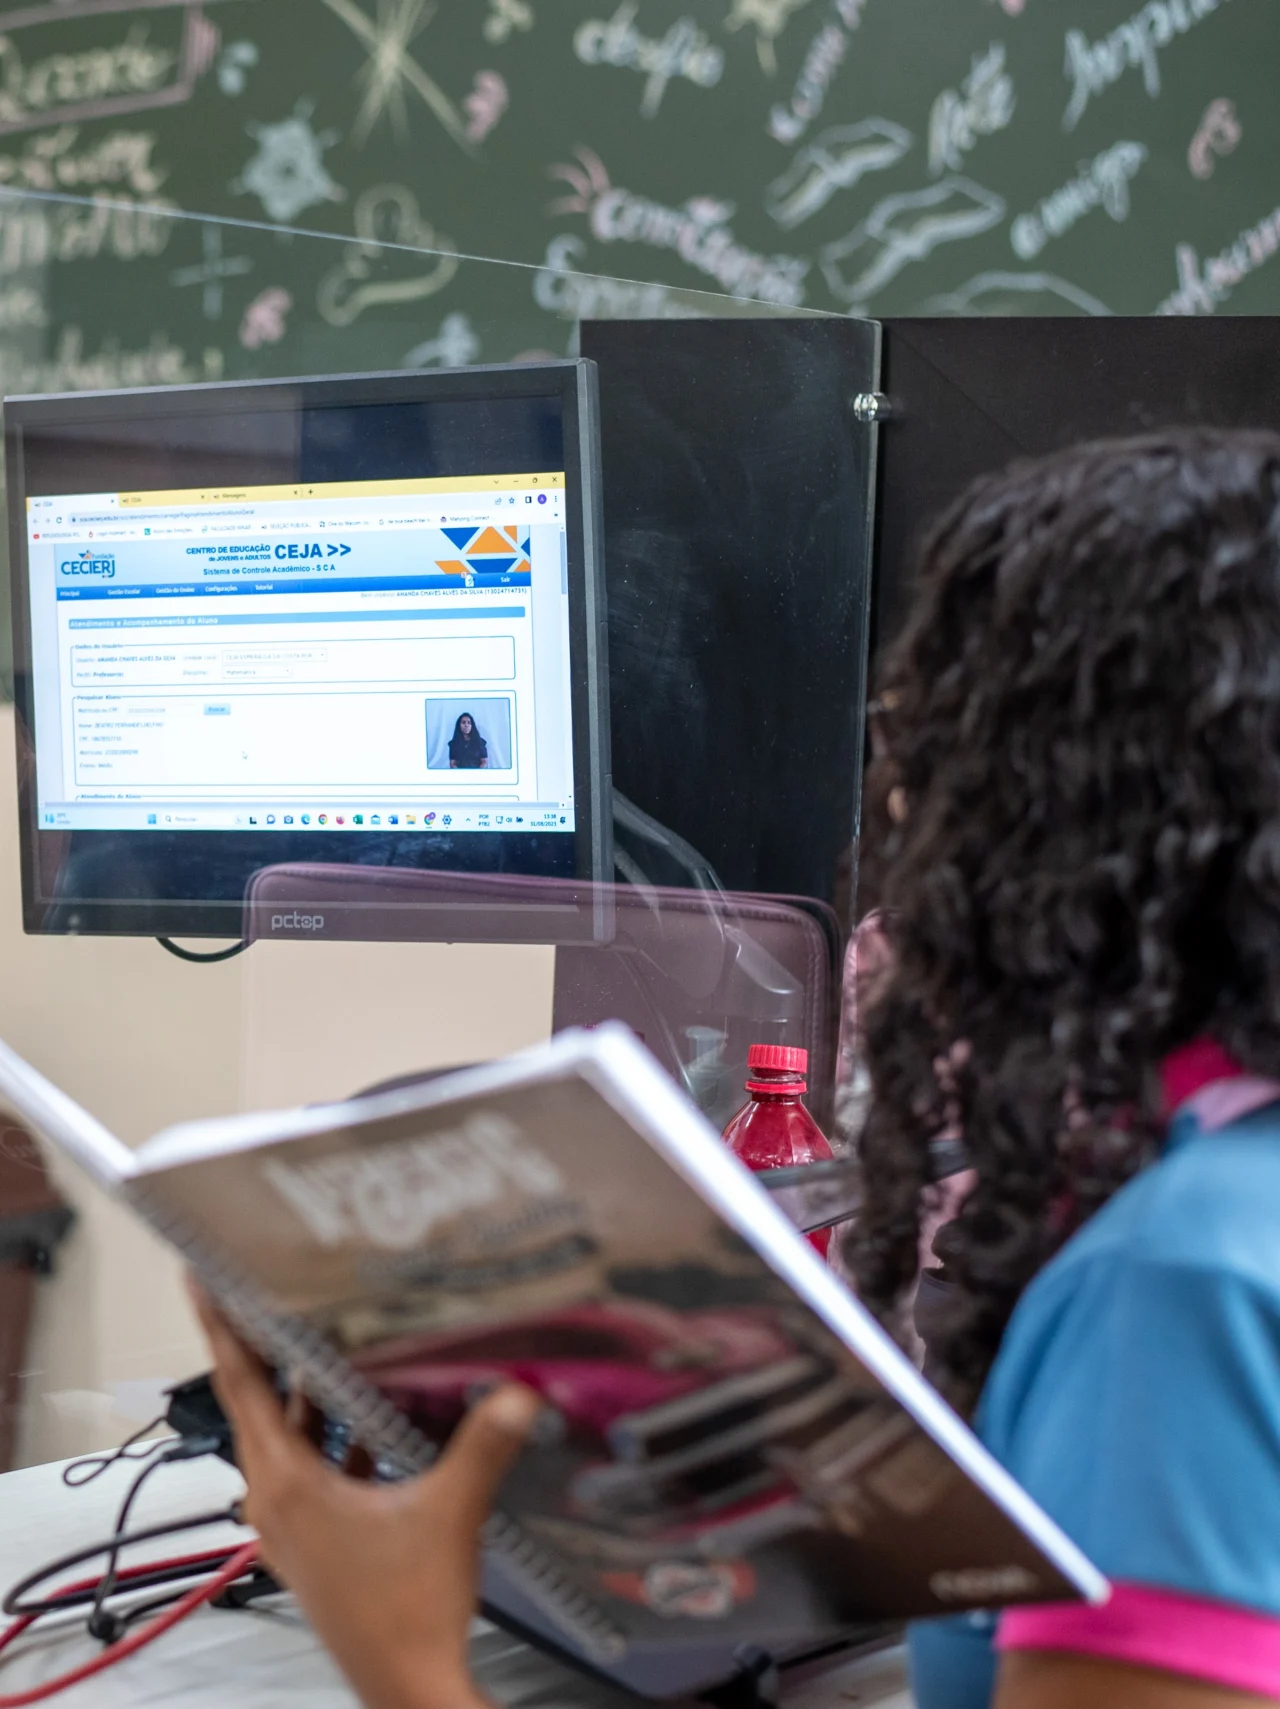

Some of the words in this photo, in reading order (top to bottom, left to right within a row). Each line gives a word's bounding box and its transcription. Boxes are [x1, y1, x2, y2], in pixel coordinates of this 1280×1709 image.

[186, 547, 217, 555] CENTRO
[230, 543, 270, 553] EDUCAÇÃO
[275, 543, 323, 560] CEJA
[61, 560, 115, 578] CECIERJ
[203, 568, 230, 576] Sistema
[242, 566, 270, 574] Controle
[272, 565, 310, 573] Acadêmico
[123, 618, 184, 627] Acompanhamento
[271, 910, 324, 931] pctop
